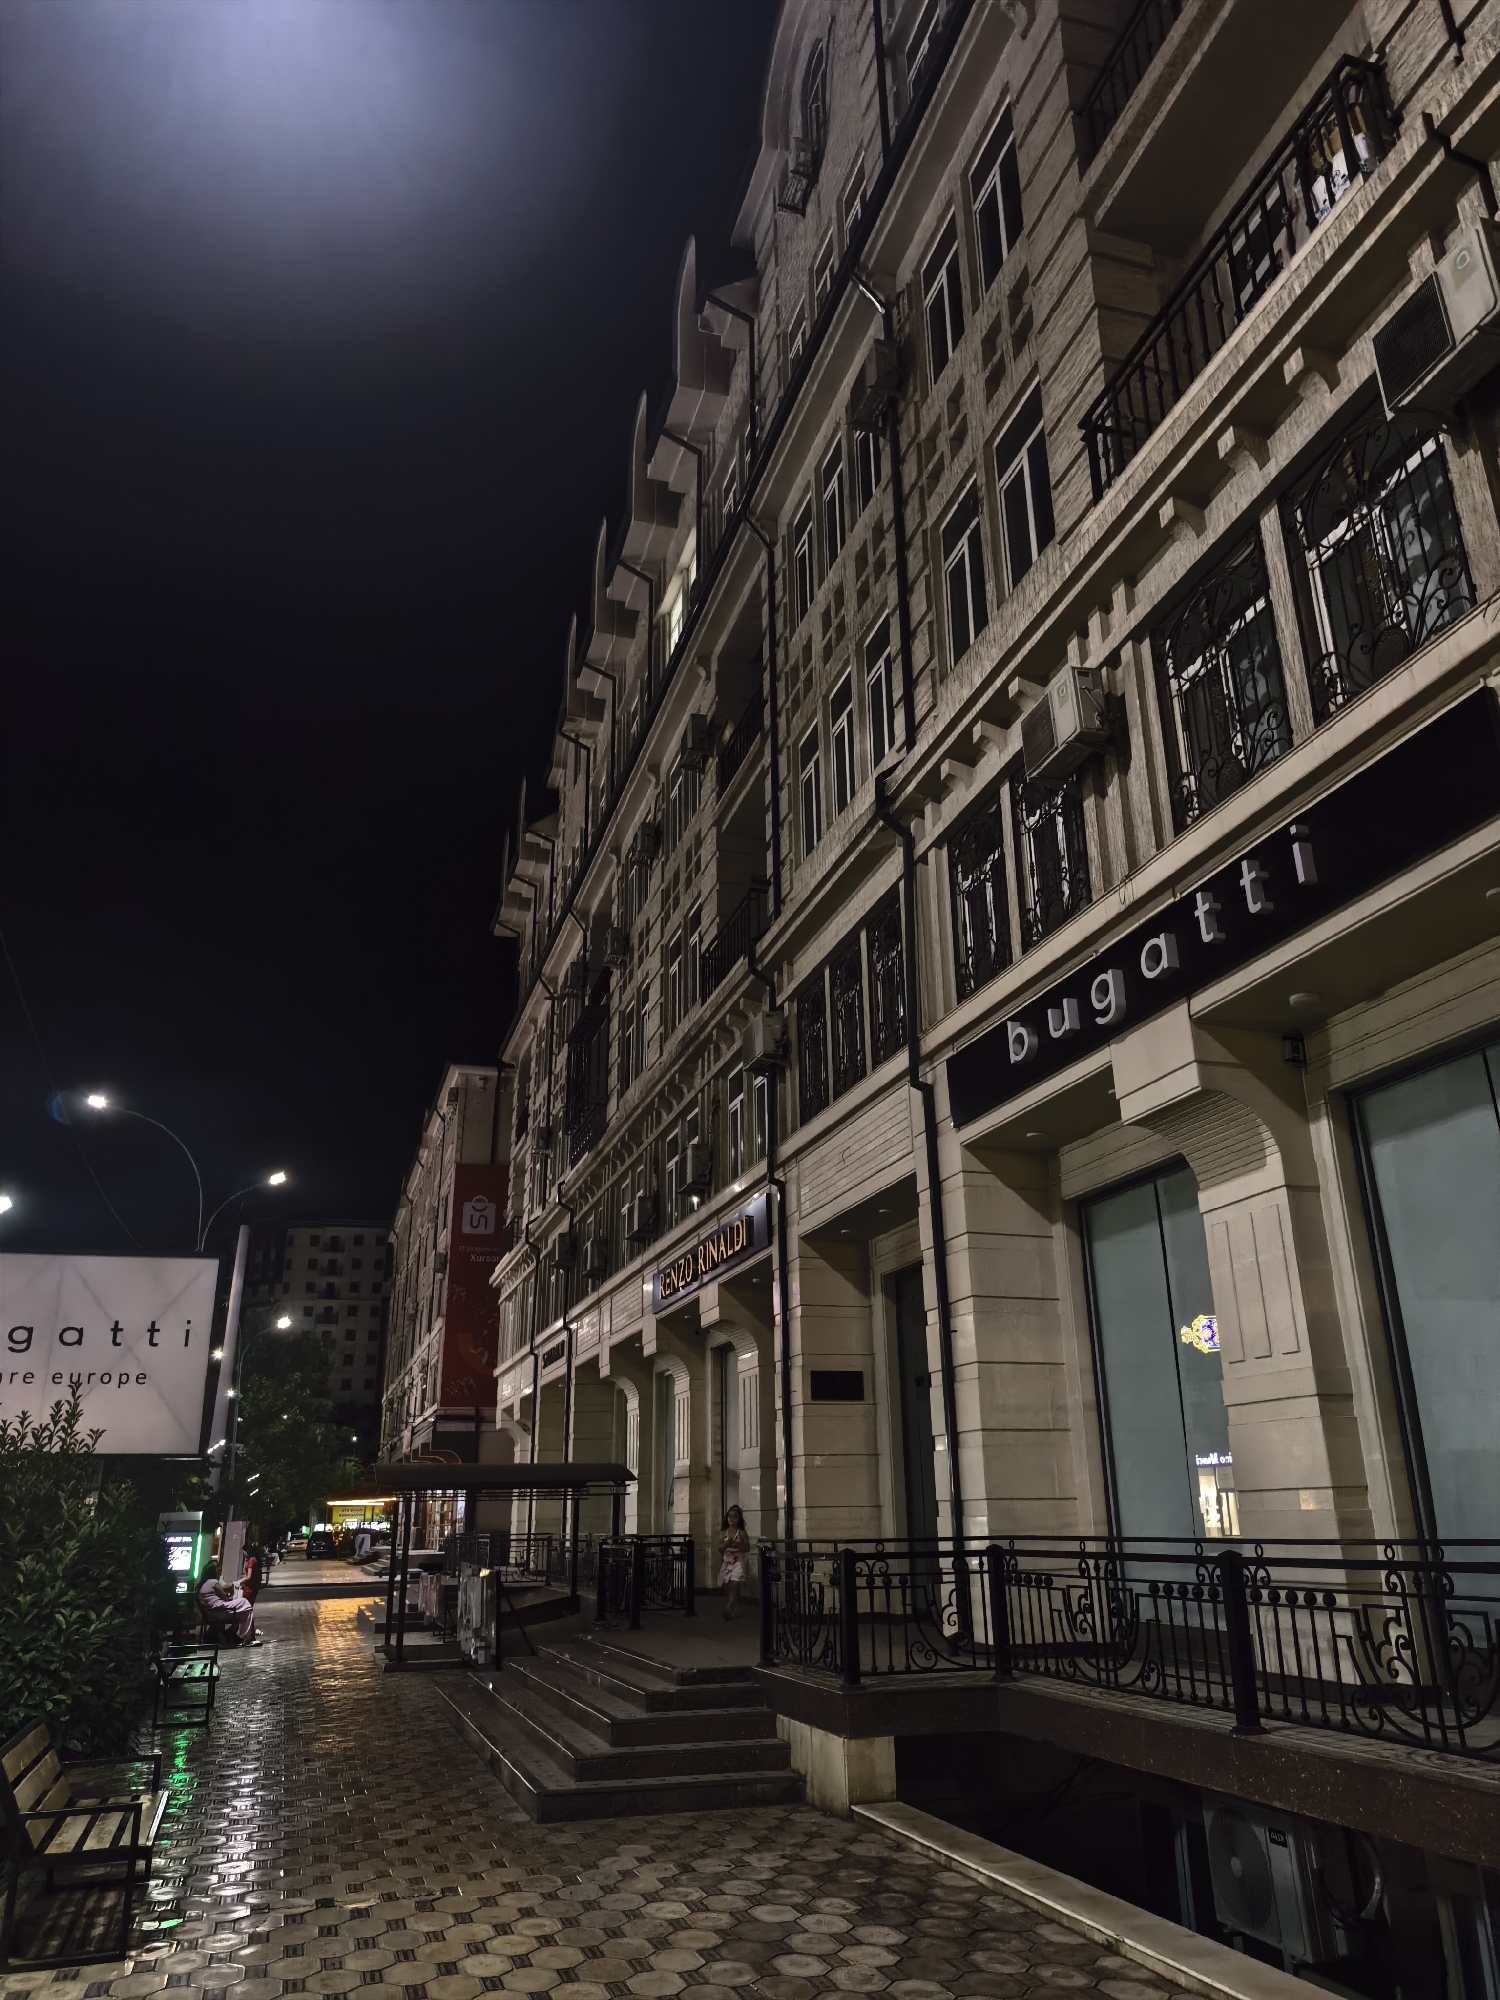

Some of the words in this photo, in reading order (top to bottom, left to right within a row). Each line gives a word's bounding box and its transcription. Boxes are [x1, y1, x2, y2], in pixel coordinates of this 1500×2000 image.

[1007, 824, 1317, 1065] bugatti
[659, 1253, 694, 1299] RENZO
[698, 1216, 748, 1275] RINALDI
[7, 1320, 192, 1353] gatti
[0, 1371, 35, 1385] re
[51, 1371, 148, 1389] europe
